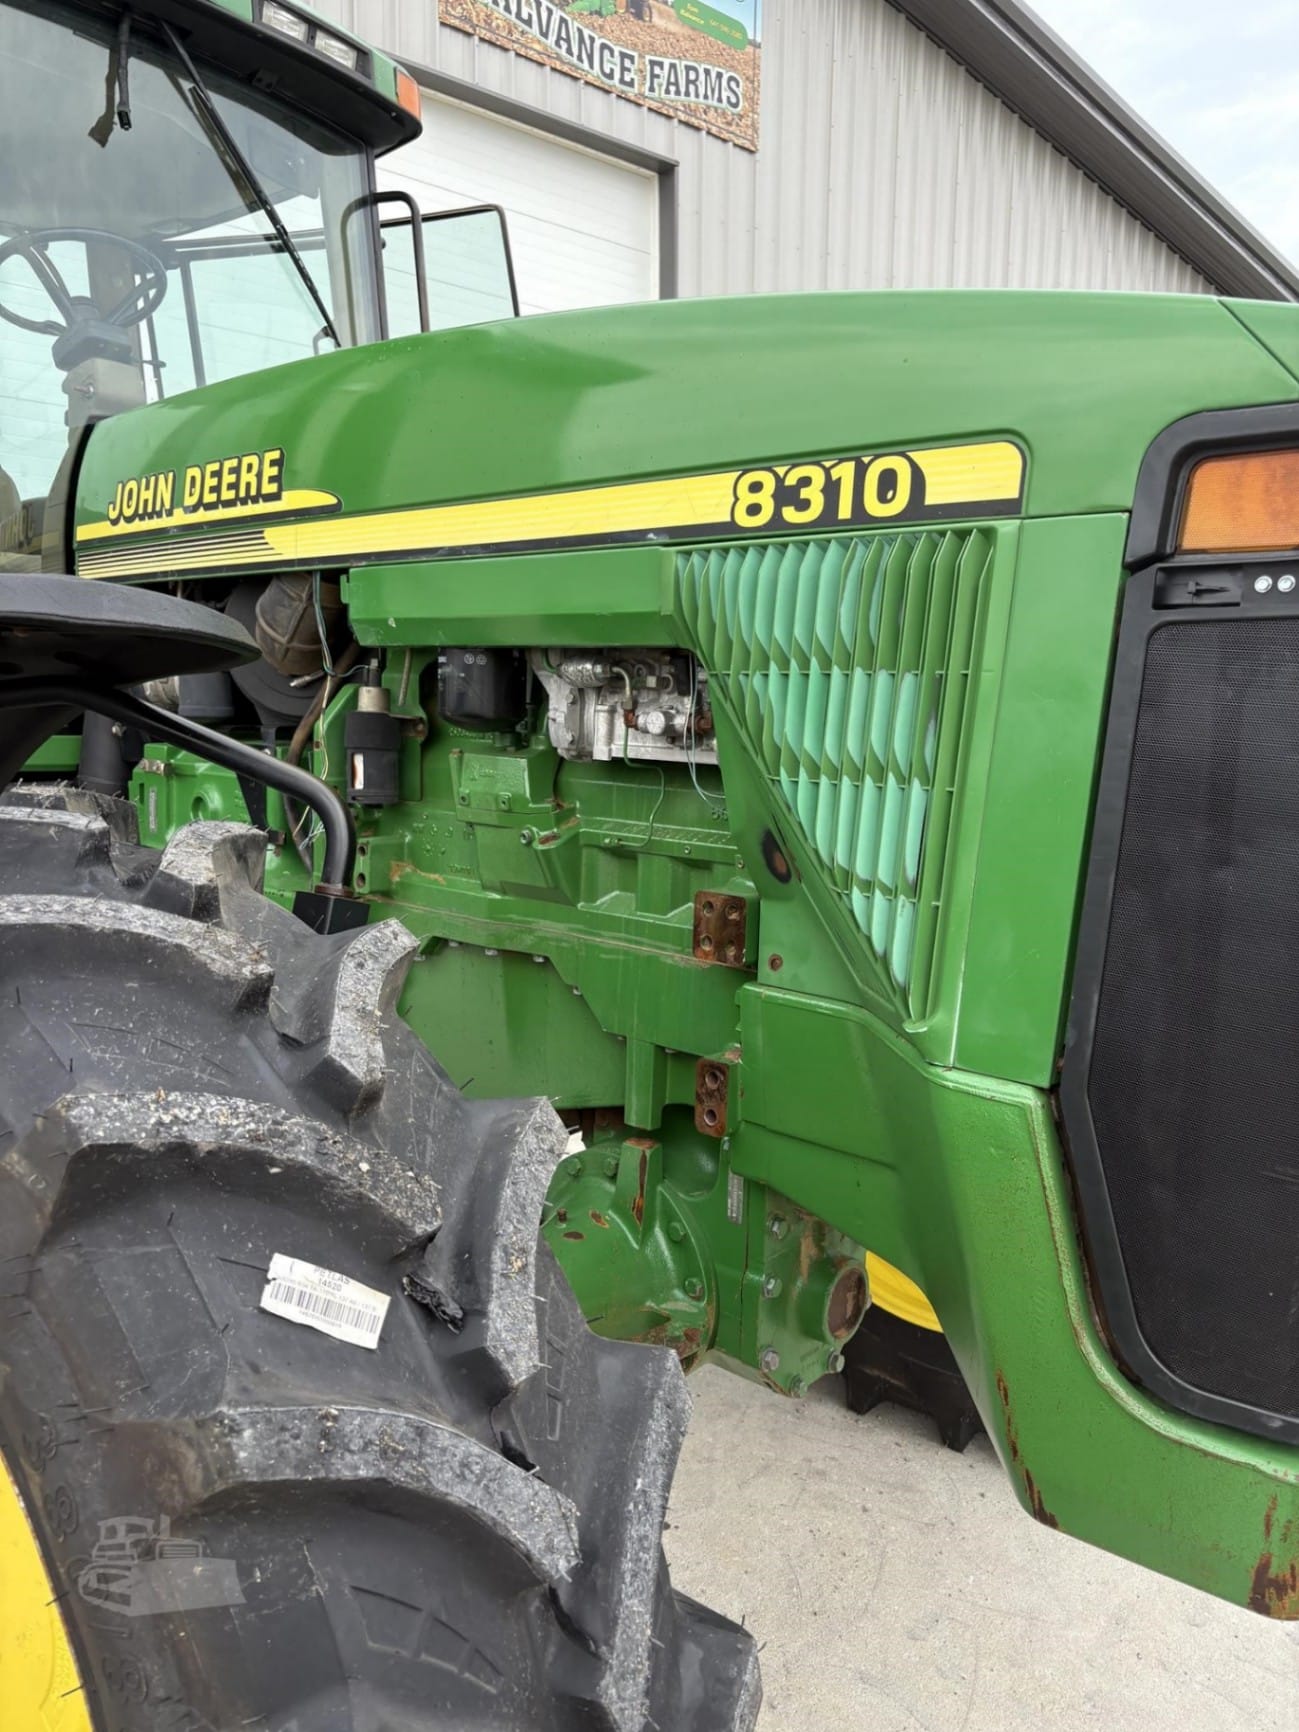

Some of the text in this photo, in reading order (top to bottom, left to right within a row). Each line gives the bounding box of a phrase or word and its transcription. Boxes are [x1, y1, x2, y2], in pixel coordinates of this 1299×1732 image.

[648, 59, 741, 109] FARMS
[108, 449, 283, 524] JOHN DEERE
[733, 455, 912, 528] 8310
